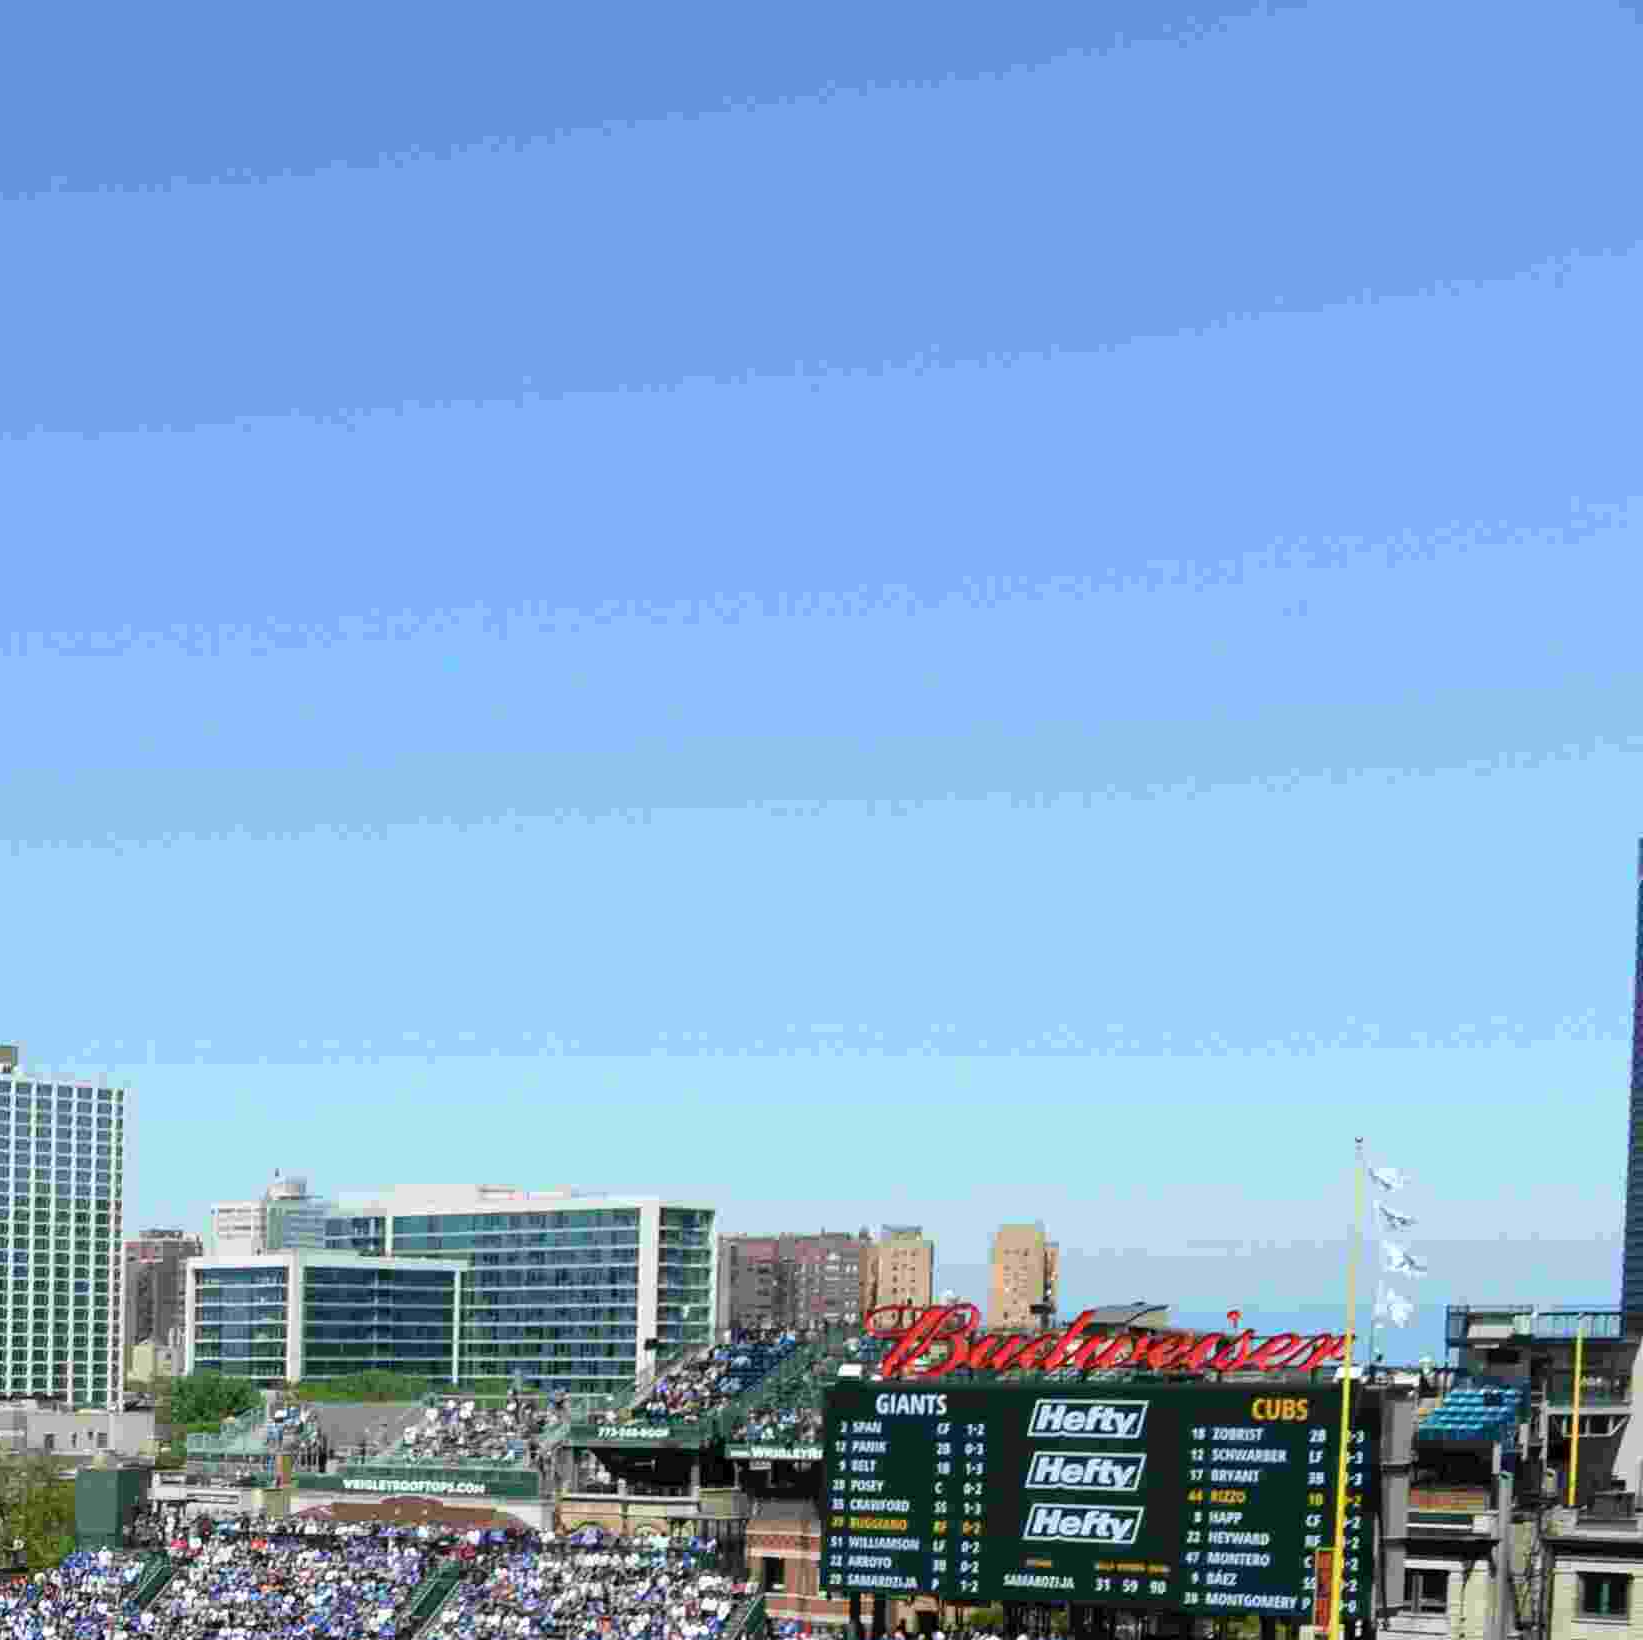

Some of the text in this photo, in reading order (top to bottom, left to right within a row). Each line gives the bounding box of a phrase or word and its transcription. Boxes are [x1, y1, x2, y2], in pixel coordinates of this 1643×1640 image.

[866, 1303, 1355, 1377] Budweiser
[875, 1393, 948, 1416] GIANTS
[1251, 1397, 1309, 1421] CUBS
[852, 1421, 883, 1434] SPAN
[966, 1423, 986, 1436] 1-2
[1035, 1404, 1140, 1437] Hefty
[1211, 1448, 1288, 1464] SCHWARBER
[1034, 1456, 1137, 1489] Hefty
[1190, 1468, 1204, 1482] 17
[934, 1481, 943, 1495] C
[963, 1481, 983, 1496] 0-2
[1031, 1508, 1135, 1541] Hefty
[1209, 1511, 1243, 1525] HAPP
[830, 1535, 843, 1549] 51
[961, 1540, 981, 1554] 0-2
[1208, 1530, 1271, 1546] HEYWARD
[960, 1559, 980, 1574] 0-2
[1185, 1551, 1201, 1565] 47
[1207, 1551, 1271, 1567] MONTERO
[960, 1579, 979, 1594] 1-2
[1149, 1581, 1167, 1595] 90
[1206, 1591, 1299, 1610] MONTGOMERY
[1301, 1596, 1313, 1610] P
